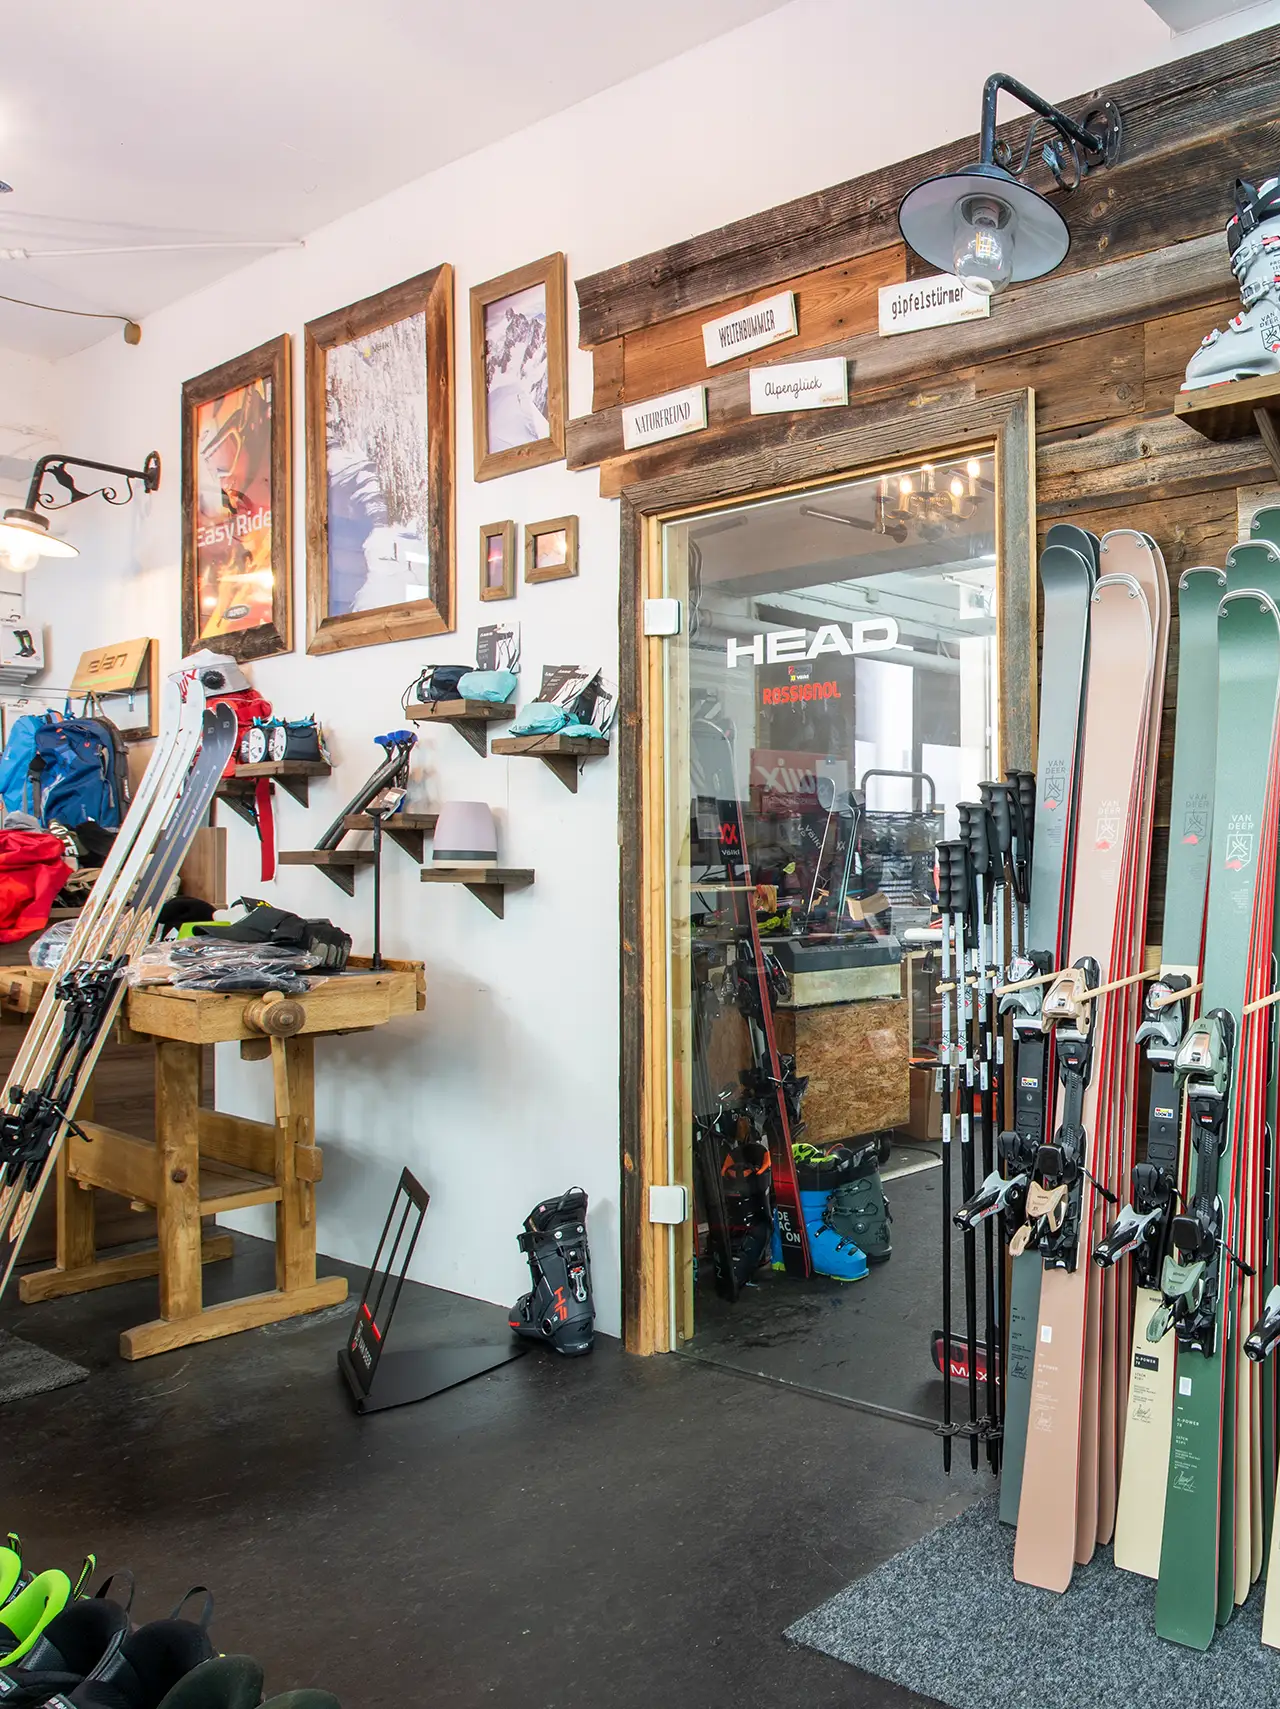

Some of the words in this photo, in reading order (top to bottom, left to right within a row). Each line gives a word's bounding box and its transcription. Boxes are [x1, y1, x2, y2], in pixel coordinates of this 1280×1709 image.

[891, 286, 964, 319] gipfelstürmer
[718, 309, 775, 348] WELTENBUMMLER
[1260, 316, 1278, 327] DEER
[1261, 311, 1275, 322] VAN
[764, 376, 822, 400] Alpenglück
[634, 401, 691, 435] NATURFREUND
[197, 523, 235, 548] Easy
[236, 507, 272, 537] Ride
[727, 617, 913, 668] HEAD
[88, 653, 128, 674] elan
[763, 681, 841, 705] ROSSIGNOL
[1228, 822, 1254, 830] DEER
[1231, 814, 1252, 822] VAN
